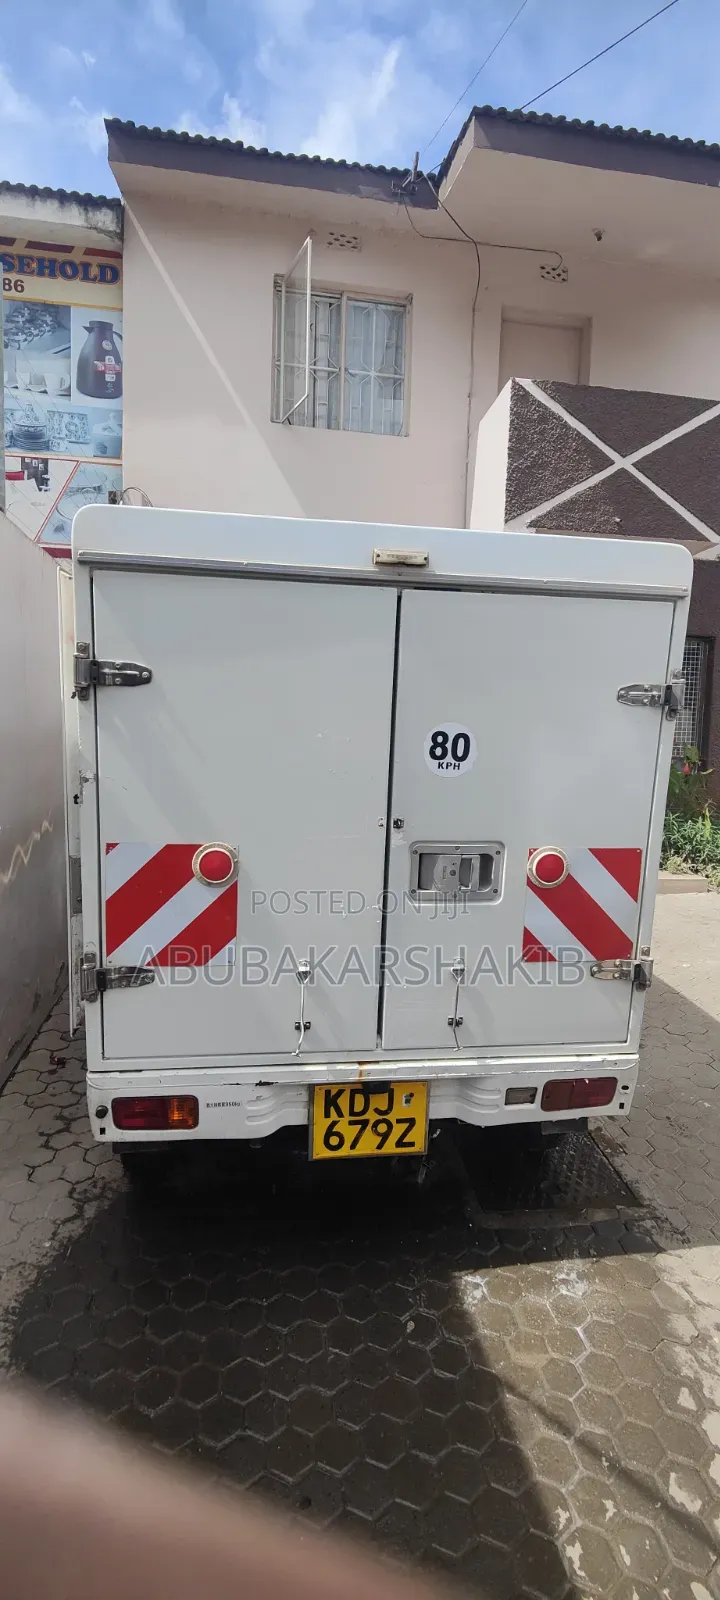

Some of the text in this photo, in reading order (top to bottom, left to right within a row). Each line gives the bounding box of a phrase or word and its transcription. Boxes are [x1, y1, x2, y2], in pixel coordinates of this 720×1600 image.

[0, 252, 120, 285] SEHOLD
[428, 730, 471, 762] 80
[437, 761, 461, 770] KPH
[323, 1088, 395, 1118] KDJ
[323, 1117, 416, 1151] 679Z
